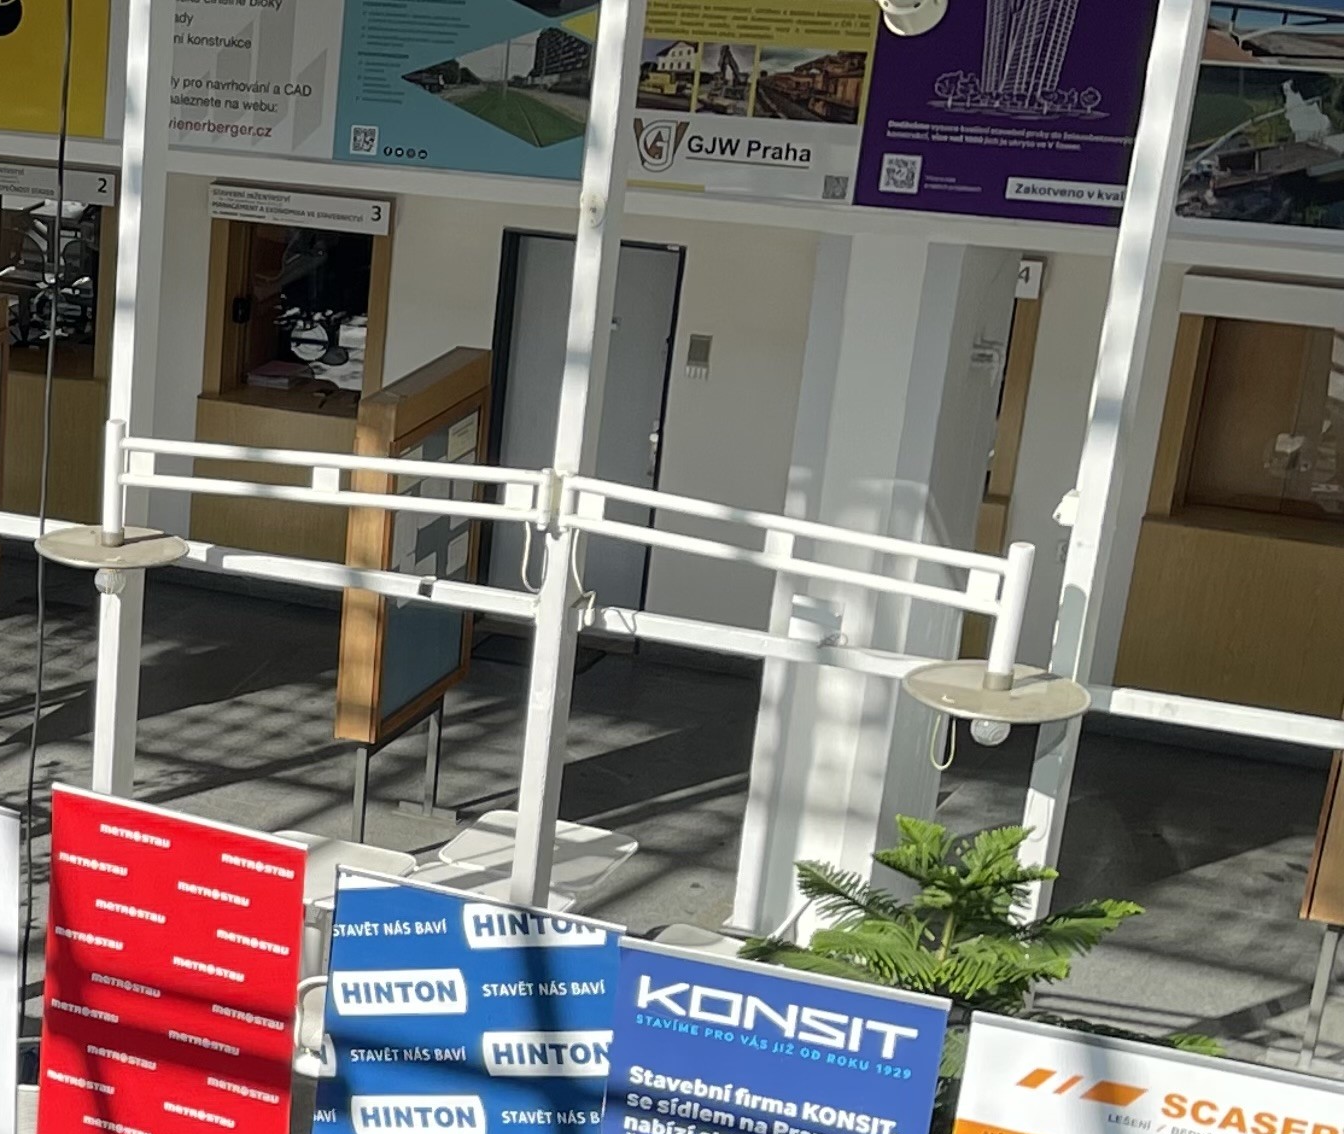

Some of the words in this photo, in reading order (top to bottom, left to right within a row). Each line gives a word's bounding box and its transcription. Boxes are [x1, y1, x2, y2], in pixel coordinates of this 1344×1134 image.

[187, 32, 252, 49] konstrukce
[183, 78, 203, 90] pro
[206, 79, 270, 94] navrhování
[284, 83, 312, 97] CAD
[224, 98, 240, 110] na
[169, 117, 273, 138] ienerberger.cz
[687, 135, 741, 157] GJW
[747, 140, 812, 163] Praha
[97, 177, 108, 194] 2
[1015, 183, 1085, 199] Zakotveno
[1088, 190, 1095, 198] v
[371, 205, 382, 222] 3
[1018, 266, 1031, 284] 4
[341, 979, 459, 1004] HINTON
[481, 979, 534, 998] STAVĚT
[538, 978, 568, 996] NÁS
[571, 978, 606, 996] BAVÍ
[637, 974, 919, 1060] KONSIT
[350, 1046, 399, 1063] STAVĚT
[403, 1045, 431, 1062] NÁS
[434, 1044, 466, 1061] BAVÍ
[492, 1041, 611, 1066] HINTON
[635, 1013, 699, 1036] STAVÍME
[704, 1027, 735, 1043] PRO
[740, 1033, 768, 1051] VÁS
[772, 1041, 795, 1055] JIŽ
[800, 1047, 821, 1061] OD
[826, 1053, 870, 1072] ROKU
[875, 1063, 913, 1081] 1929
[628, 1064, 732, 1104] Stavební
[735, 1086, 798, 1119] firma
[361, 1105, 478, 1129] HINTON
[626, 1091, 653, 1111] se
[656, 1094, 737, 1131] sídlem
